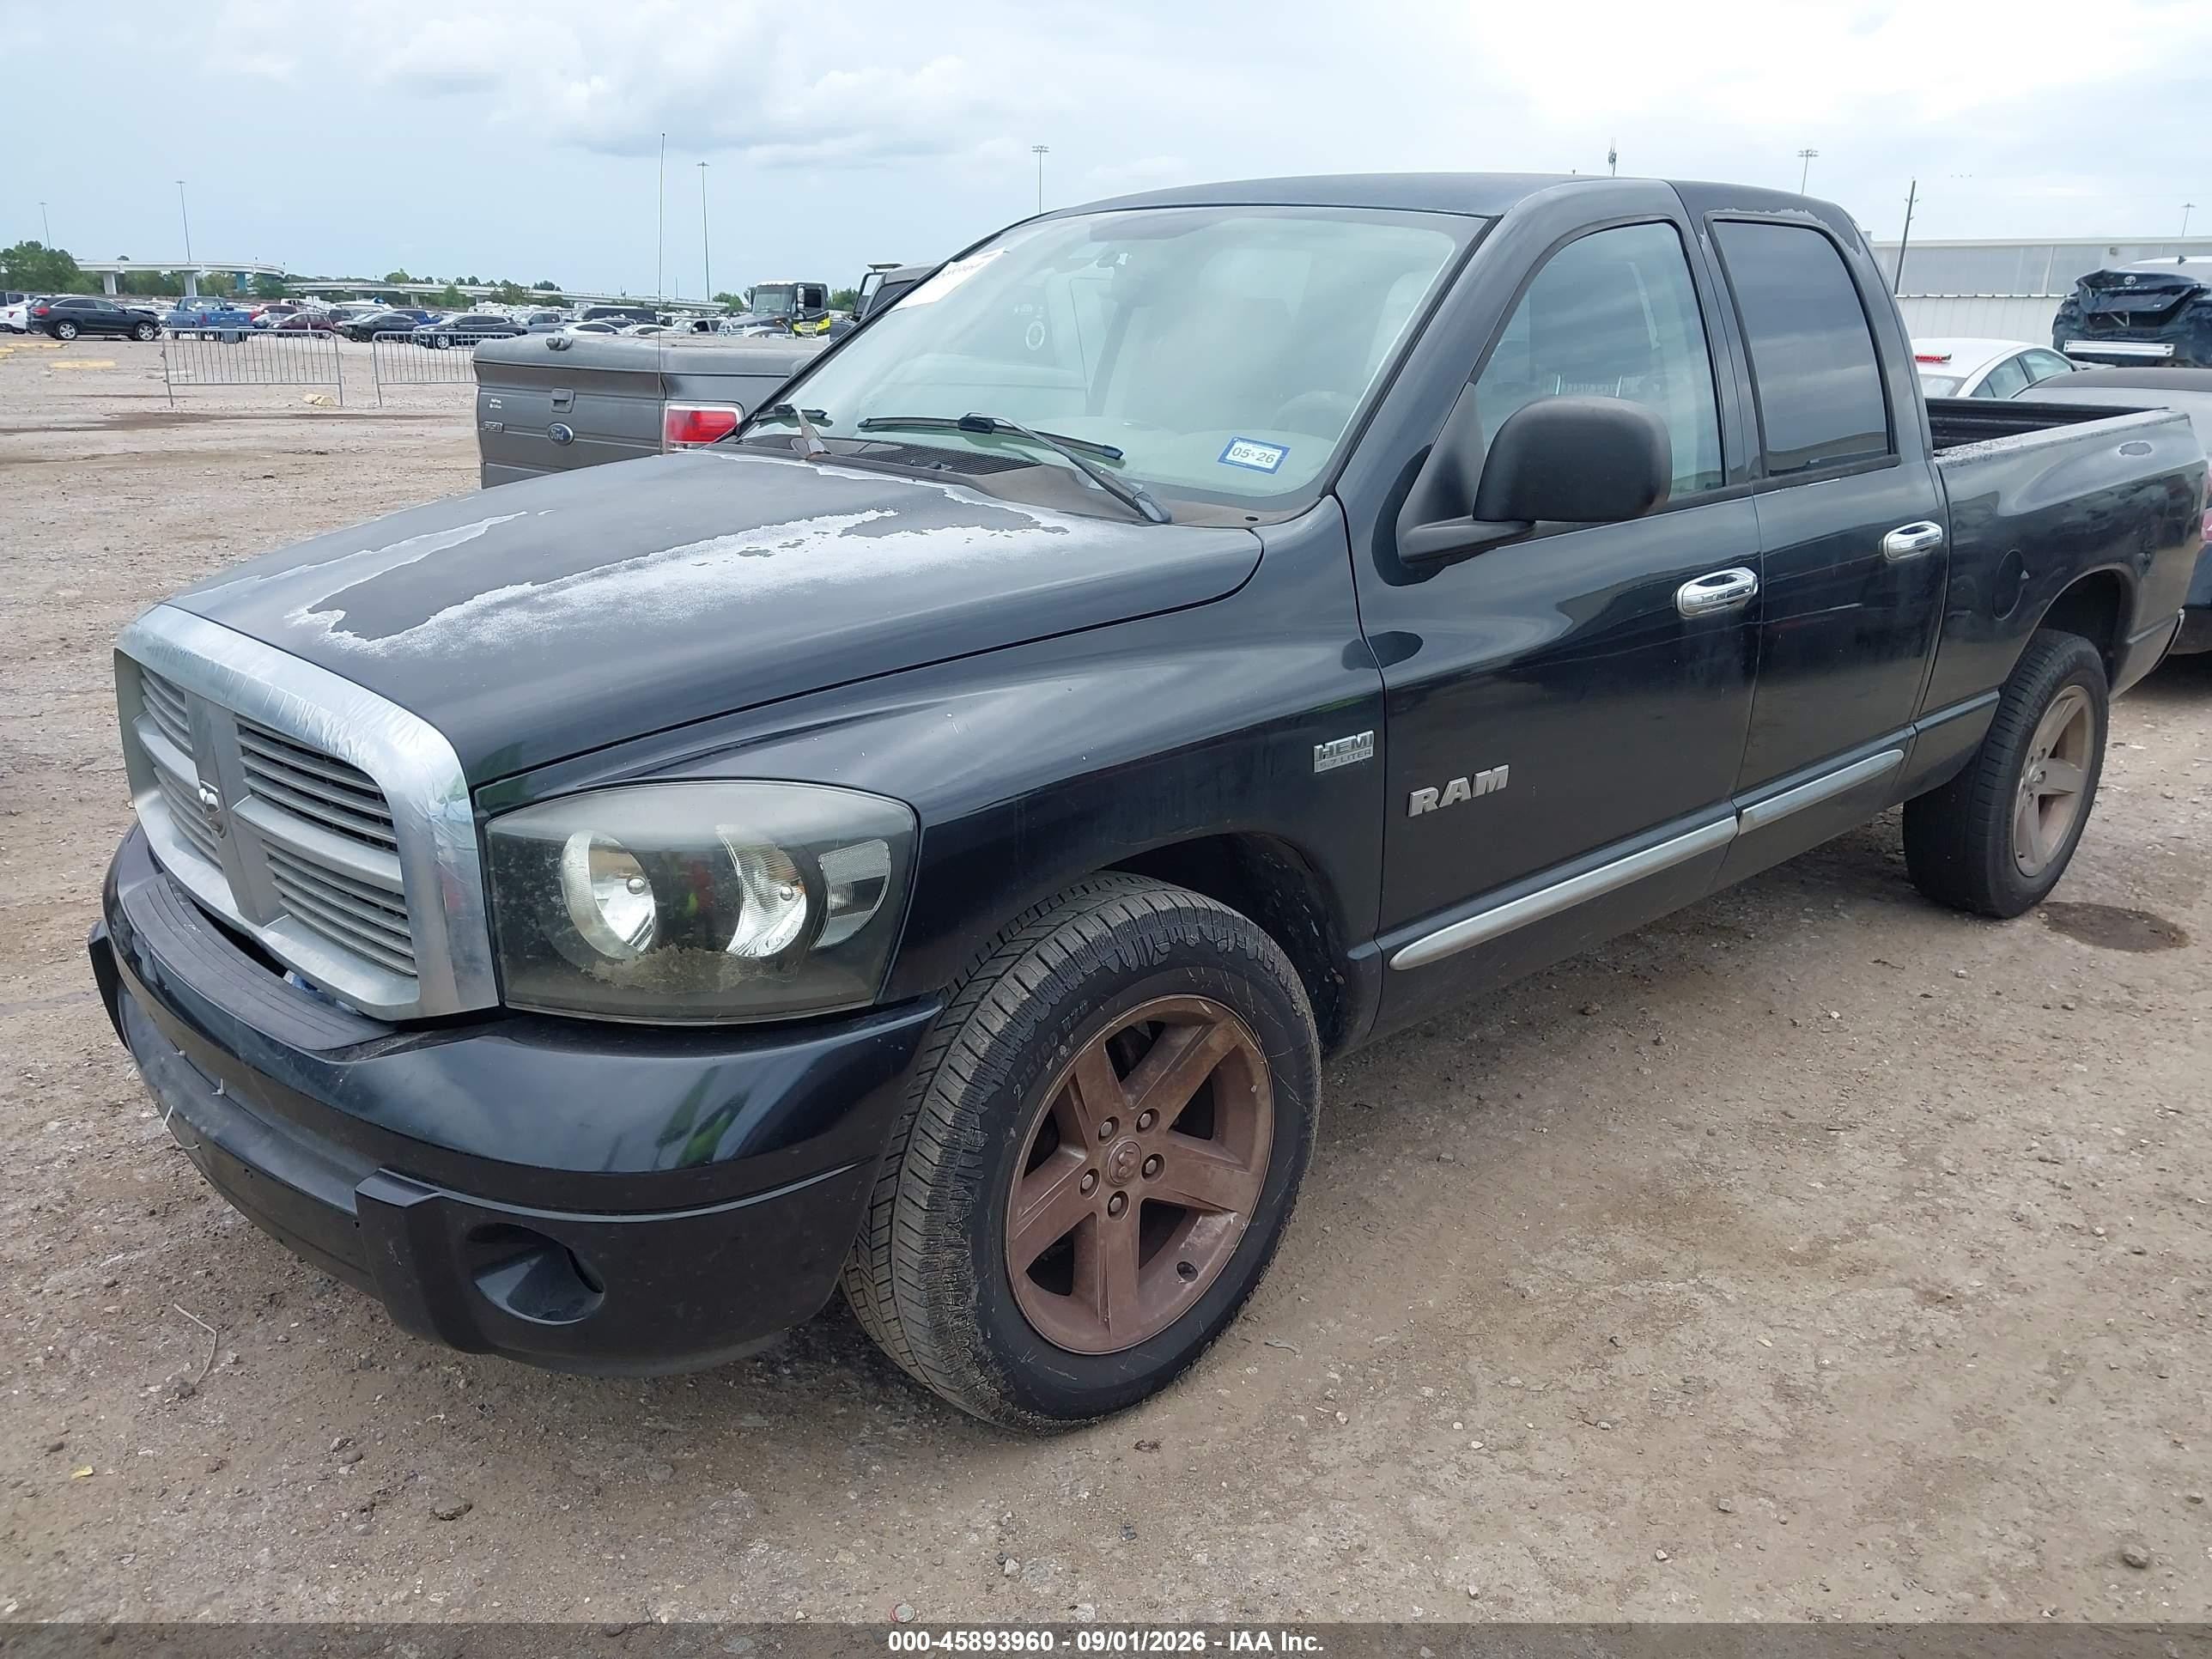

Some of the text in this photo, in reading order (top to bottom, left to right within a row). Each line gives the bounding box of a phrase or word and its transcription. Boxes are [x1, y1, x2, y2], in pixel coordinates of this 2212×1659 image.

[1314, 730, 1374, 762] HEMI
[1340, 750, 1371, 763] LITER
[1407, 763, 1510, 817] RAM
